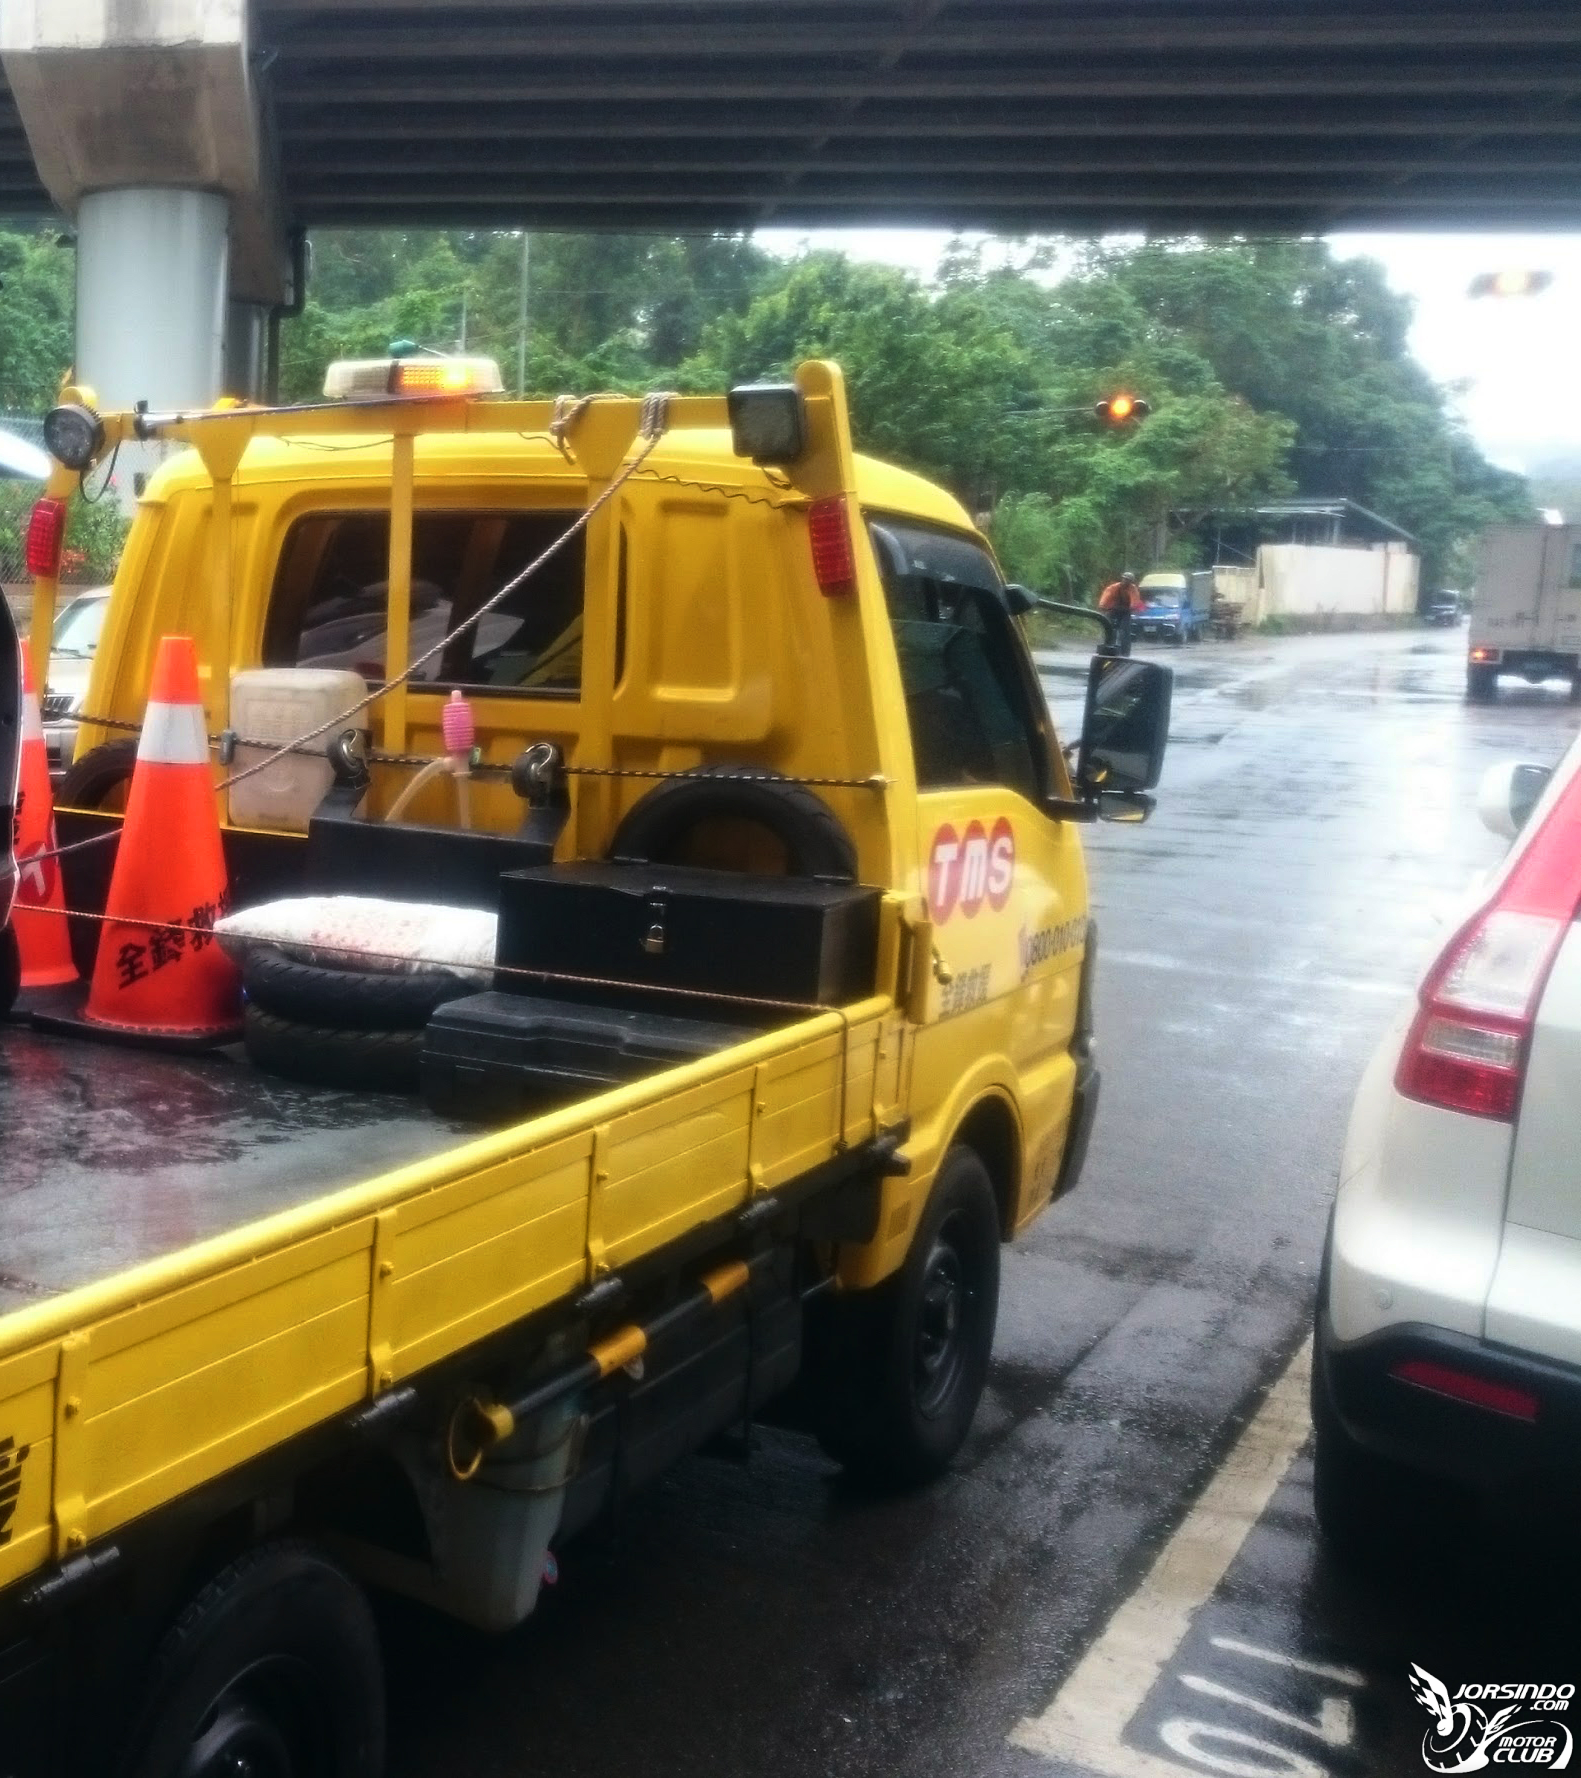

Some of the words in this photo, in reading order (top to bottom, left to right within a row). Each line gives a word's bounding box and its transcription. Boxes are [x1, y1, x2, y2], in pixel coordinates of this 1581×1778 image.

[930, 833, 1015, 908] TMS
[115, 892, 232, 992] 全鋒救
